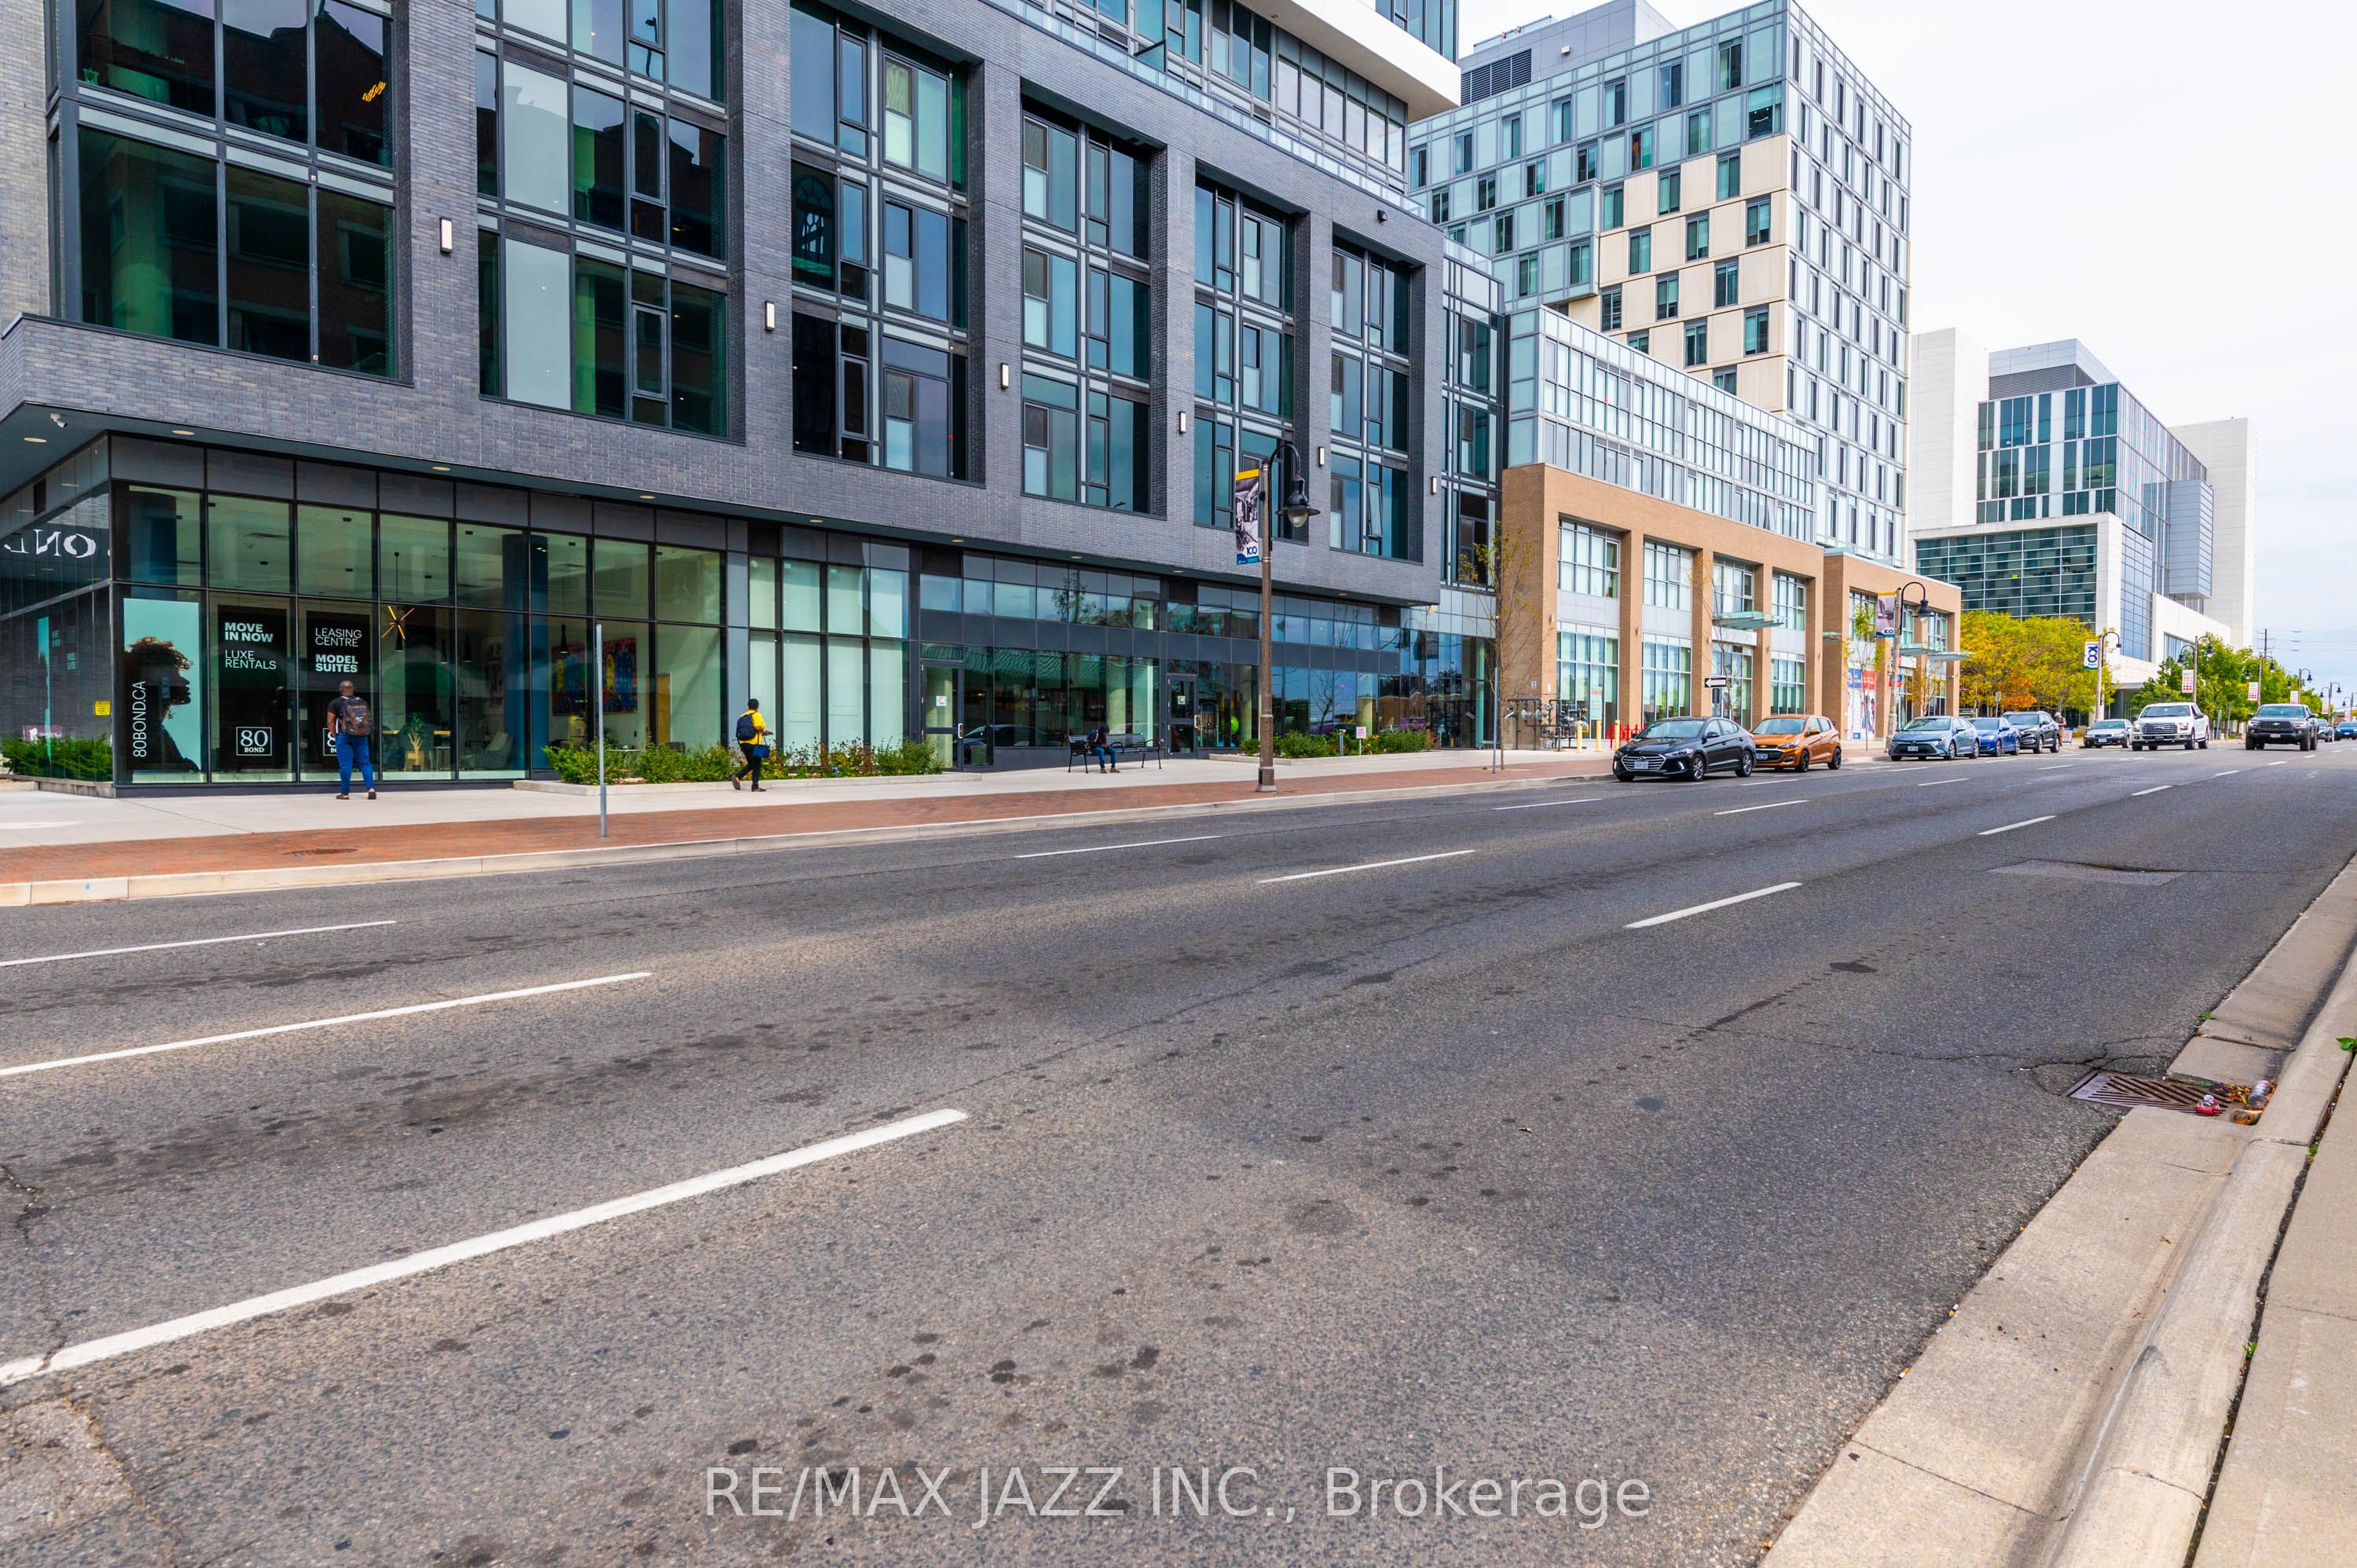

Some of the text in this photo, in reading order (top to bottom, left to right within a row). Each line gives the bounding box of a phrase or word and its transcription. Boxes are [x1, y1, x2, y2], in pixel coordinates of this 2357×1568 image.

[225, 622, 263, 632] MOVE
[225, 632, 274, 643] IN NOW
[315, 628, 362, 639] LEASING
[315, 636, 359, 647] CENTRE
[225, 650, 255, 660] LUXE
[315, 654, 359, 665] MODEL
[225, 659, 277, 670] RENTALS
[315, 663, 358, 673] SUITES
[132, 680, 147, 757] 80BOND.CA
[240, 730, 269, 747] 80
